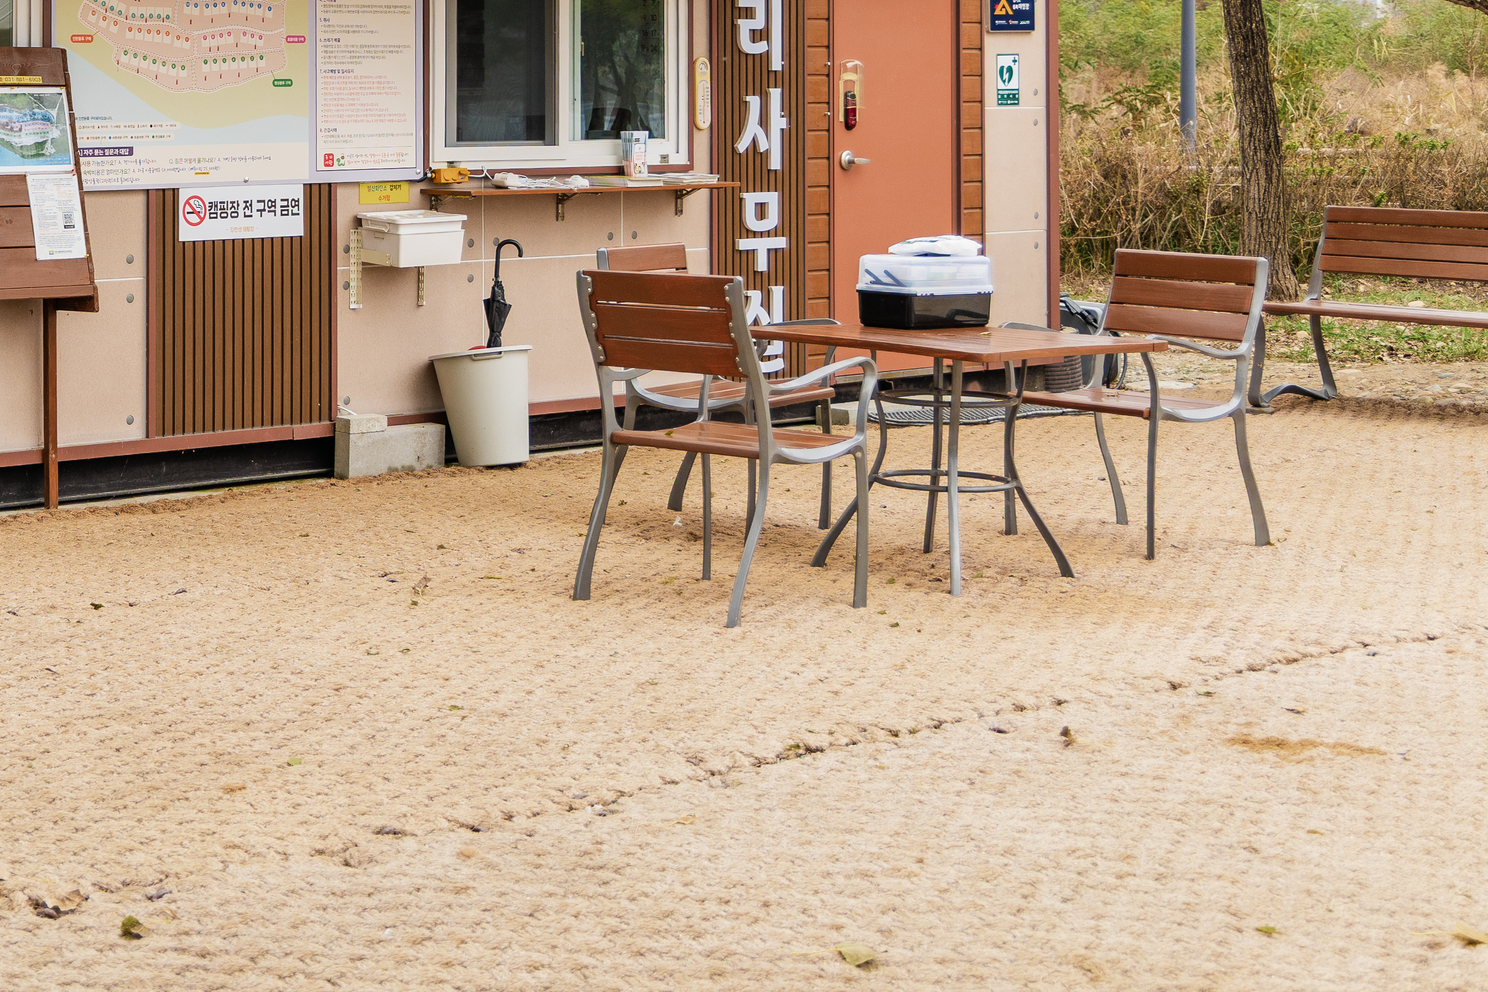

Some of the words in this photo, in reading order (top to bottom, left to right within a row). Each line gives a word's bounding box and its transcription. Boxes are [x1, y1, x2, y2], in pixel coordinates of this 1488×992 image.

[208, 200, 240, 220] 캠핑장
[242, 200, 254, 218] 전
[256, 198, 277, 218] 구역
[280, 198, 300, 217] 금연
